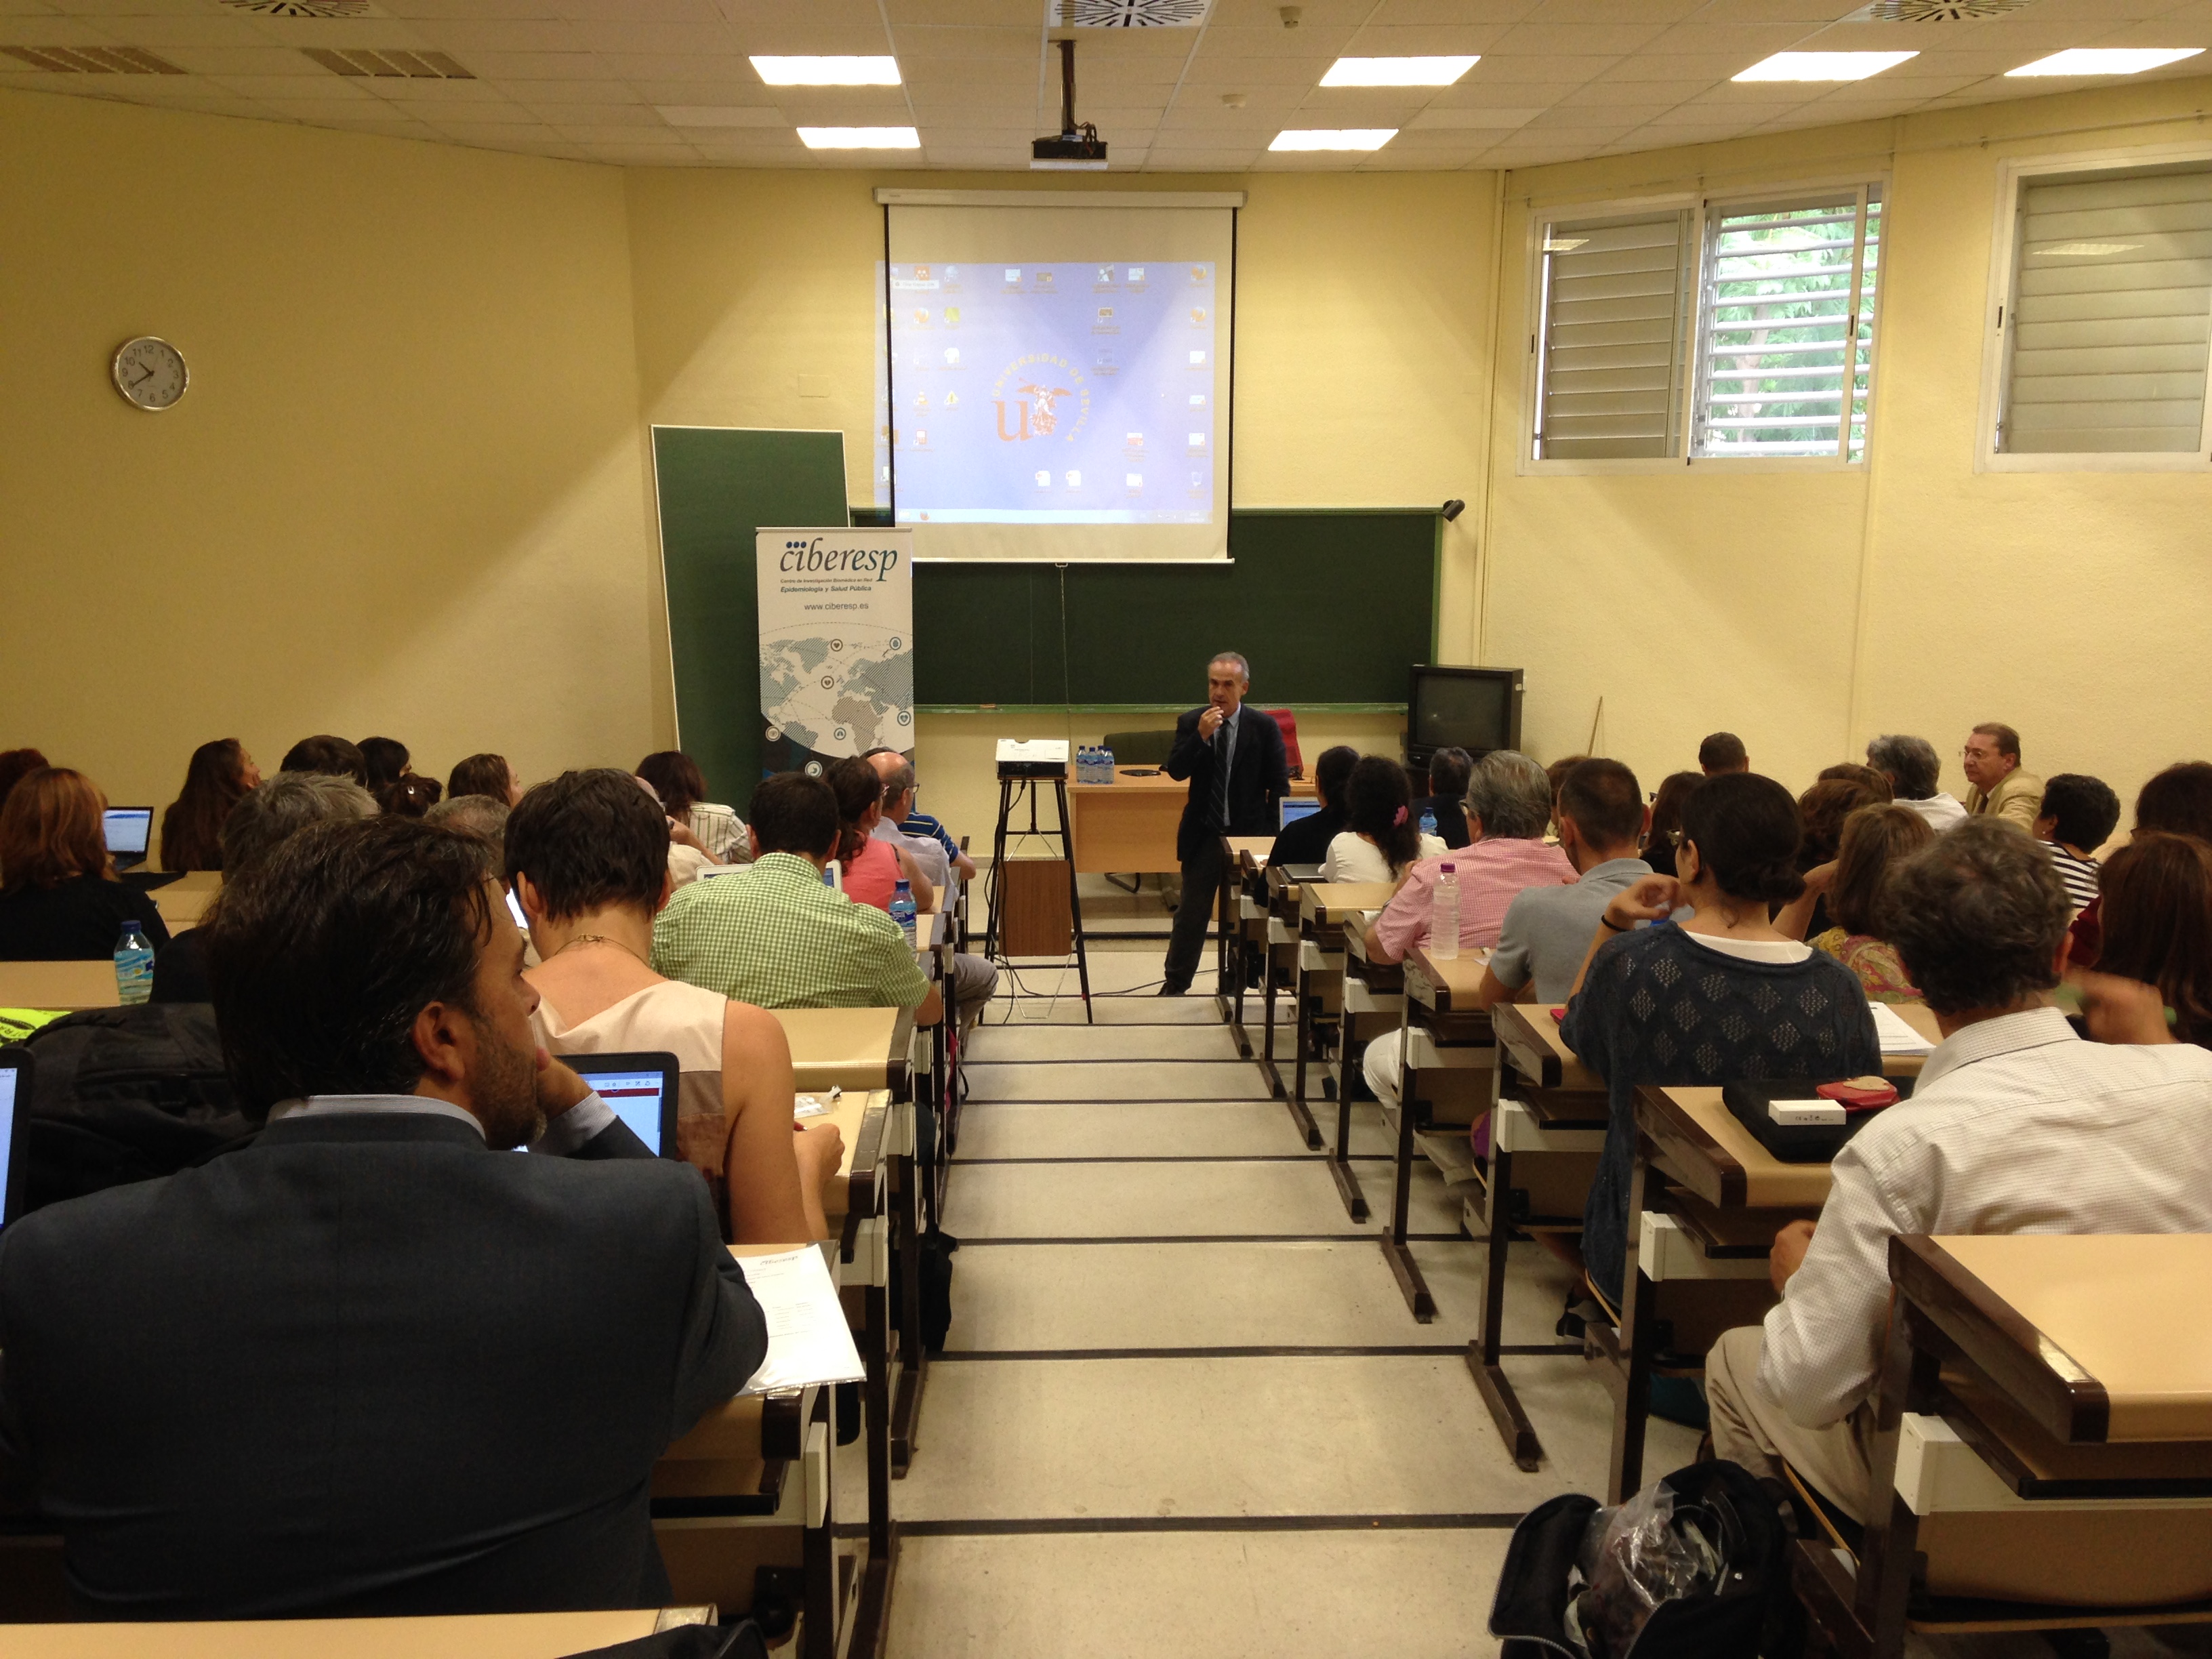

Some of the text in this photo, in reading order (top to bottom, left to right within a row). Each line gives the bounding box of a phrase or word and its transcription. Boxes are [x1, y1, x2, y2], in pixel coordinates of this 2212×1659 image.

[132, 348, 142, 357] 11
[144, 345, 154, 354] 12
[161, 350, 164, 358] 1
[125, 356, 136, 367] 10
[167, 358, 173, 367] 2
[122, 367, 128, 377] 9
[173, 370, 179, 379] 3
[169, 382, 176, 391] 4
[138, 388, 143, 397] 7
[162, 389, 168, 399] 5
[149, 393, 156, 403] 6
[779, 537, 898, 582] ciberesp
[804, 602, 869, 611] www.ciberesp.es
